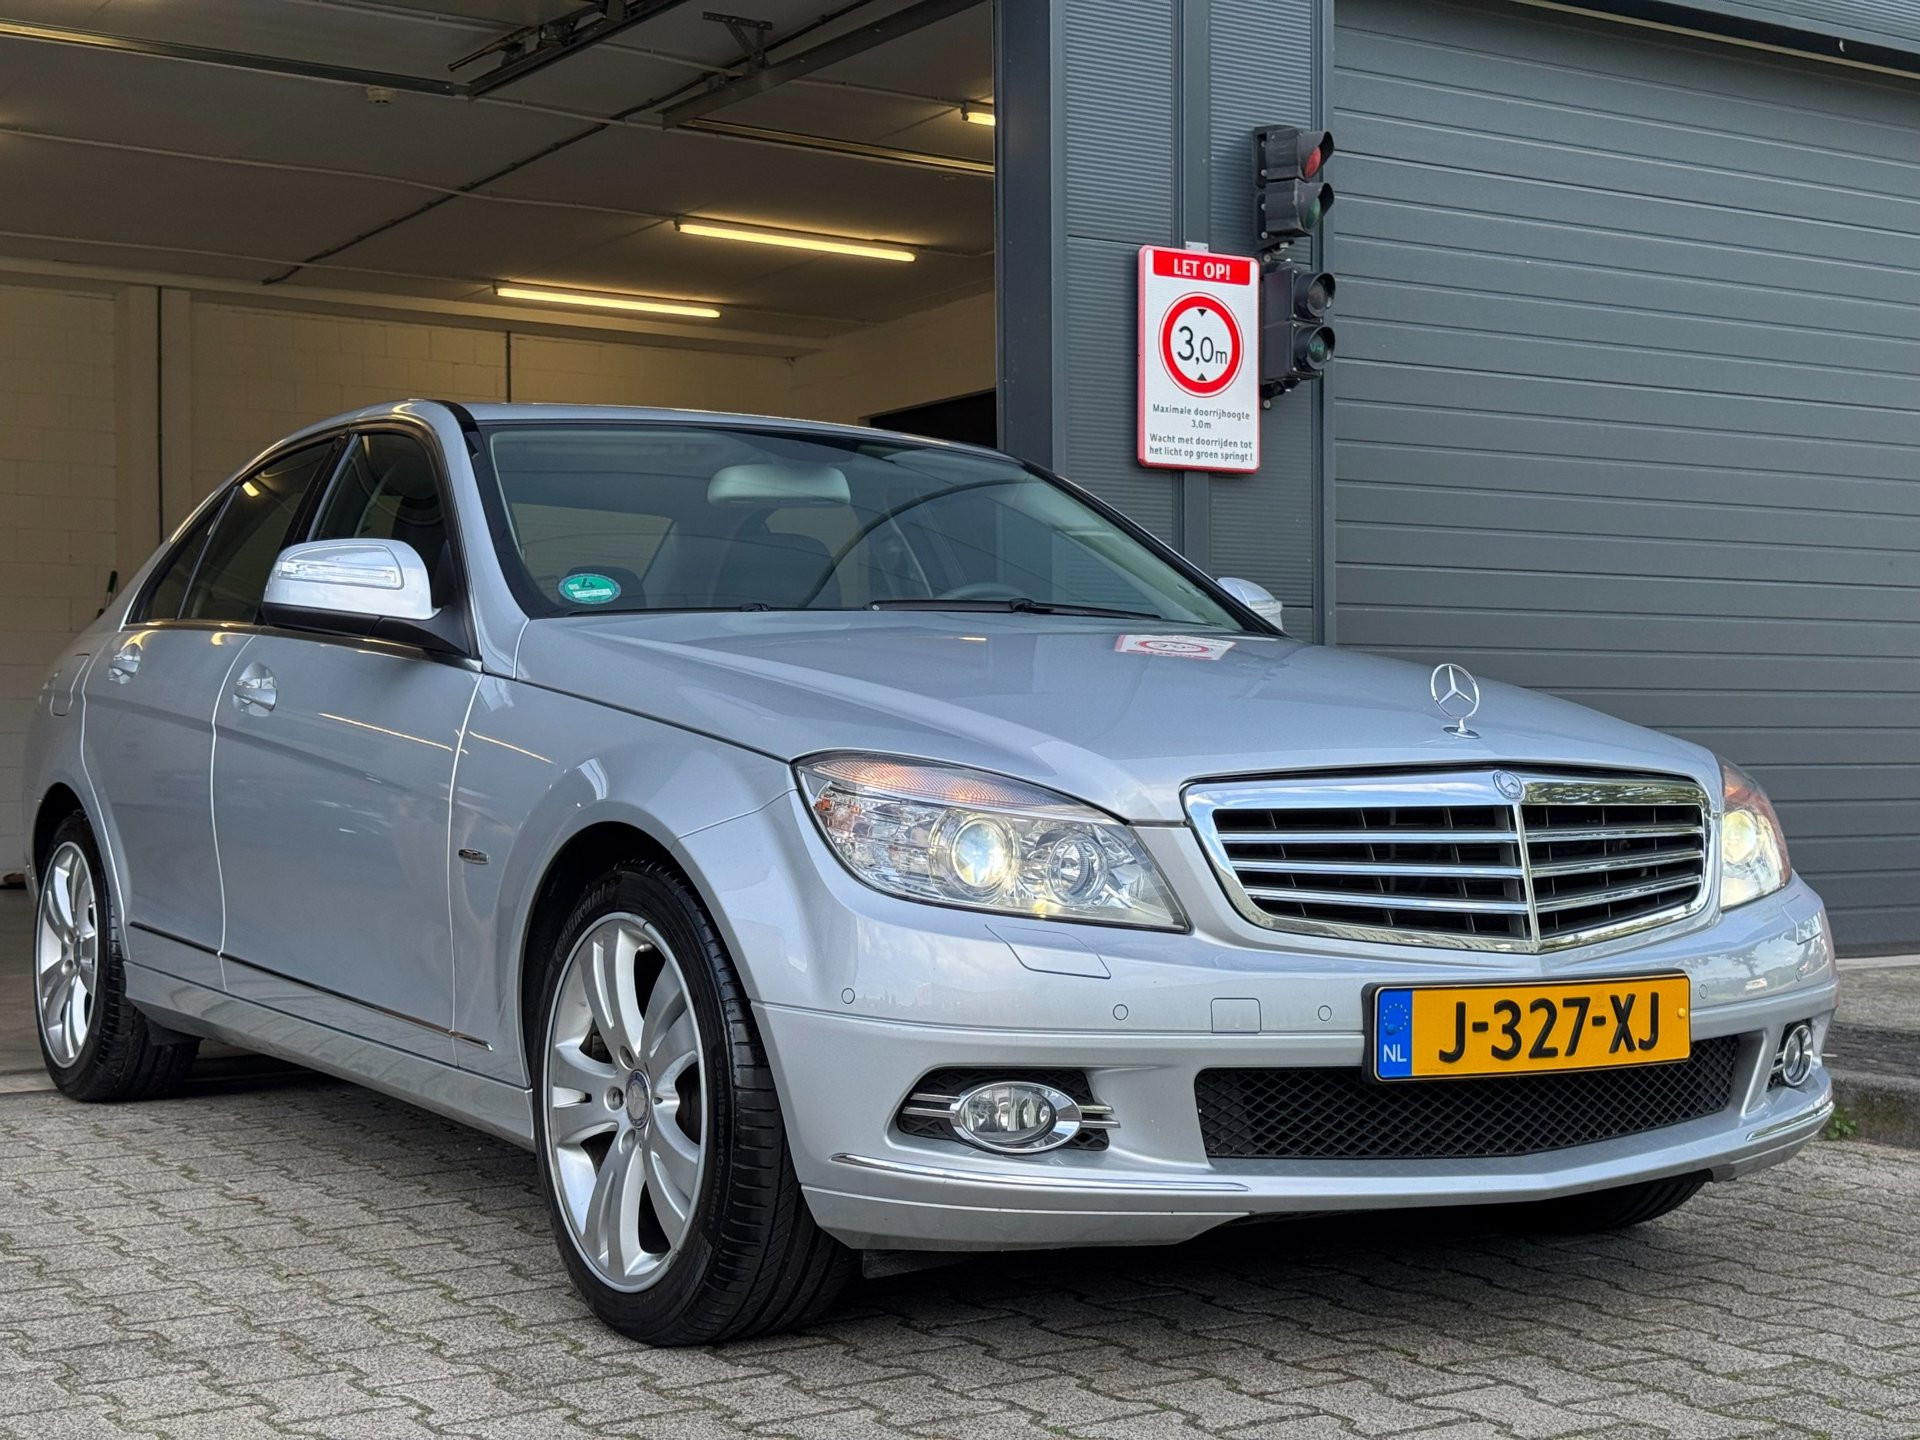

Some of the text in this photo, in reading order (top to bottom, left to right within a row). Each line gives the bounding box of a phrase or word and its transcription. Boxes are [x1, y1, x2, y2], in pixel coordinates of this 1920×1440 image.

[1173, 258, 1231, 281] LET OP!
[1177, 325, 1228, 365] 3,0m
[1153, 403, 1250, 421] Maximale doorrijhoogte
[1191, 419, 1212, 429] 3,0m
[1150, 433, 1252, 449] Wacht met doorrijden tot
[1149, 446, 1162, 455] het
[1164, 446, 1182, 456] licht
[1184, 450, 1194, 459] op
[1196, 450, 1218, 460] groen
[1220, 452, 1248, 463] springt
[1438, 991, 1660, 1064] J-327-XJ
[1383, 1043, 1407, 1063] NL
